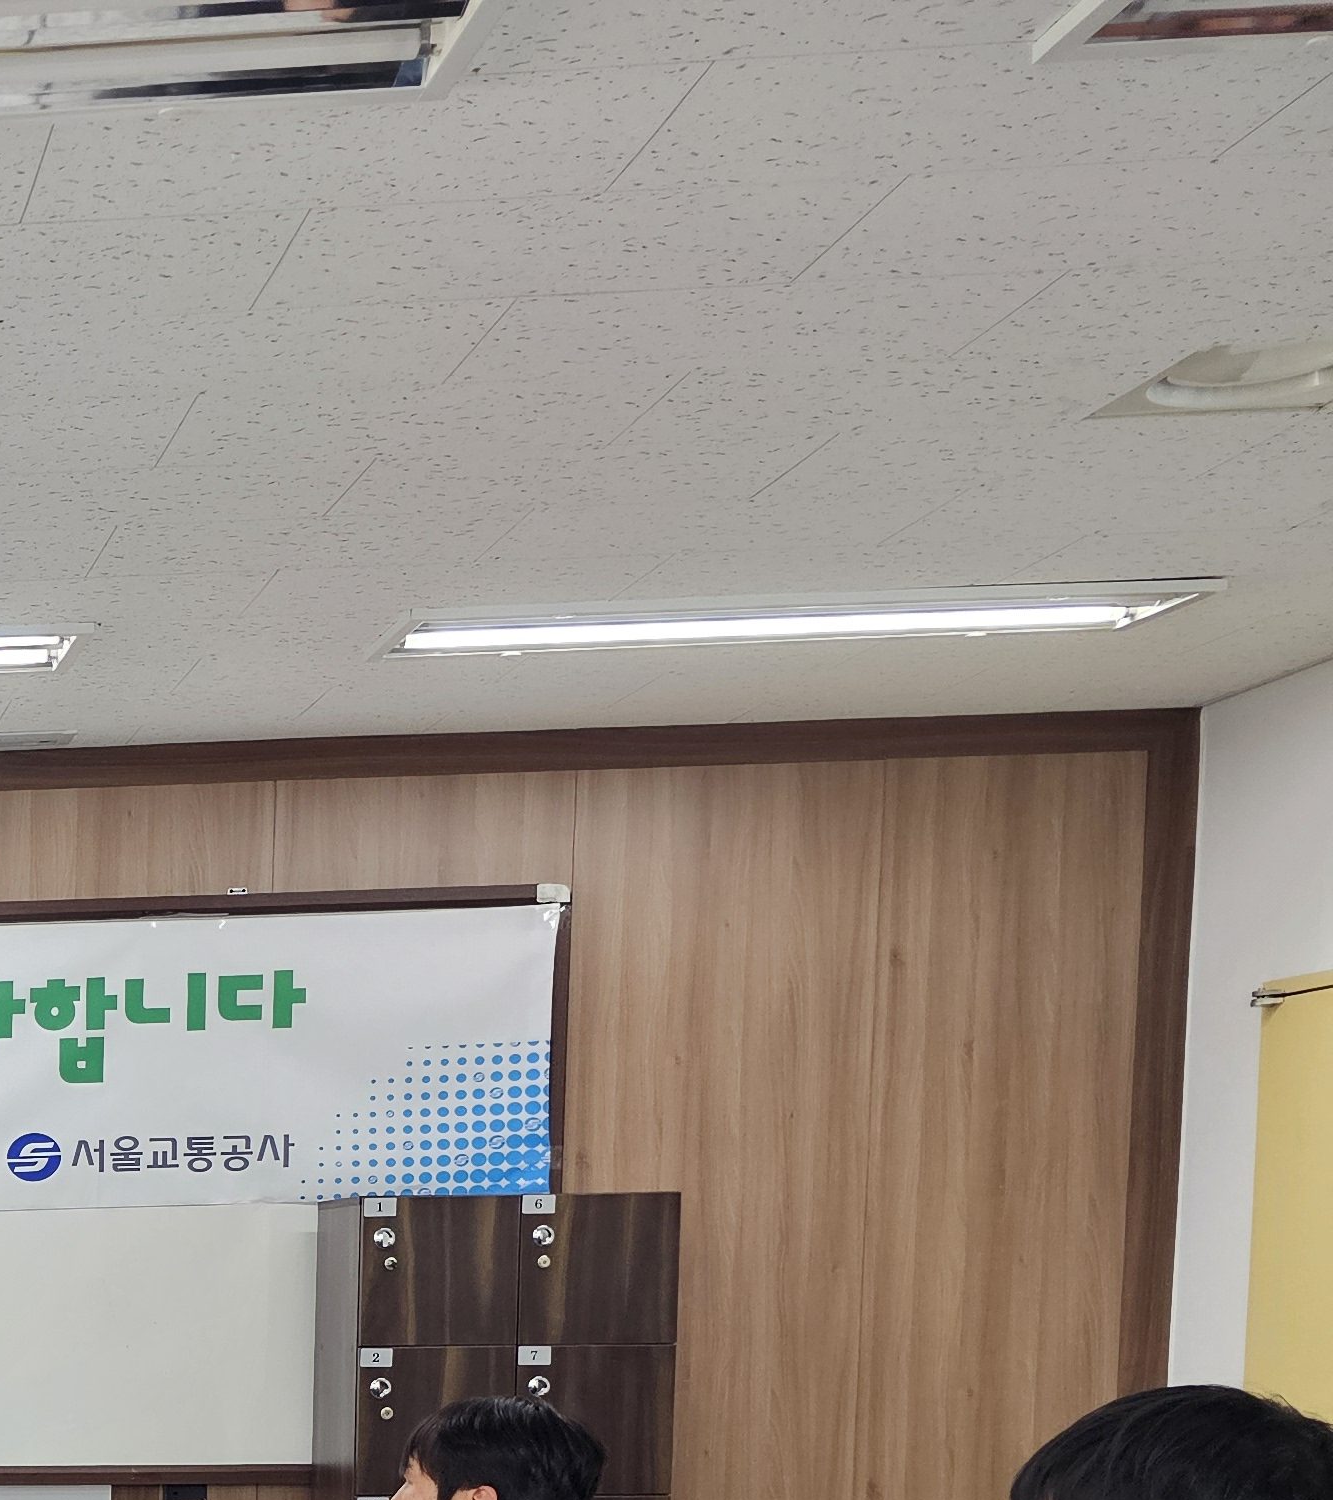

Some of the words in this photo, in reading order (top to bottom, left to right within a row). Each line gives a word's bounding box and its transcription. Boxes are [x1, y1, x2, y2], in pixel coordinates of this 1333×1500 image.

[71, 1133, 295, 1173] 서울교통공사
[534, 1198, 543, 1210] 6
[371, 1352, 380, 1363] 2
[530, 1350, 538, 1361] 7
